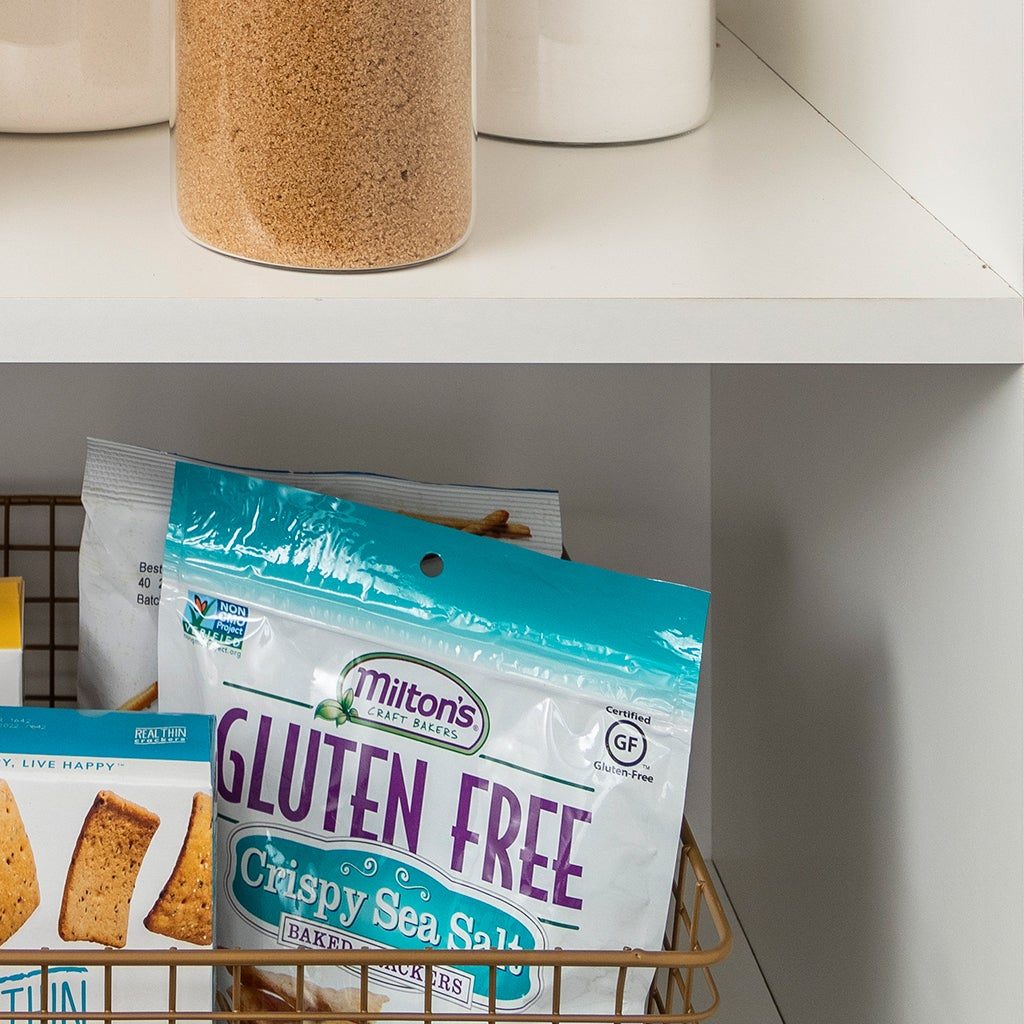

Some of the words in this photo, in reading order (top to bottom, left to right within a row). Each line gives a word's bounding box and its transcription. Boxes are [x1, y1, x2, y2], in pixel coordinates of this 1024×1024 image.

[139, 562, 163, 574] Best
[138, 577, 151, 588] 40
[136, 594, 161, 606] Batc
[220, 601, 246, 617] NON
[216, 622, 244, 636] Project
[367, 706, 409, 724] CRAFT
[412, 717, 459, 740] BAKERS
[605, 705, 652, 725] Certified
[134, 728, 159, 739] REAL
[160, 727, 187, 738] THIN
[614, 734, 638, 753] GF
[22, 759, 56, 769] LIVE
[593, 760, 654, 784] Gluten-Free
[216, 707, 429, 855] GLUTEN
[450, 771, 593, 911] FREE
[240, 846, 368, 928] Crispy
[373, 887, 441, 947] Sea
